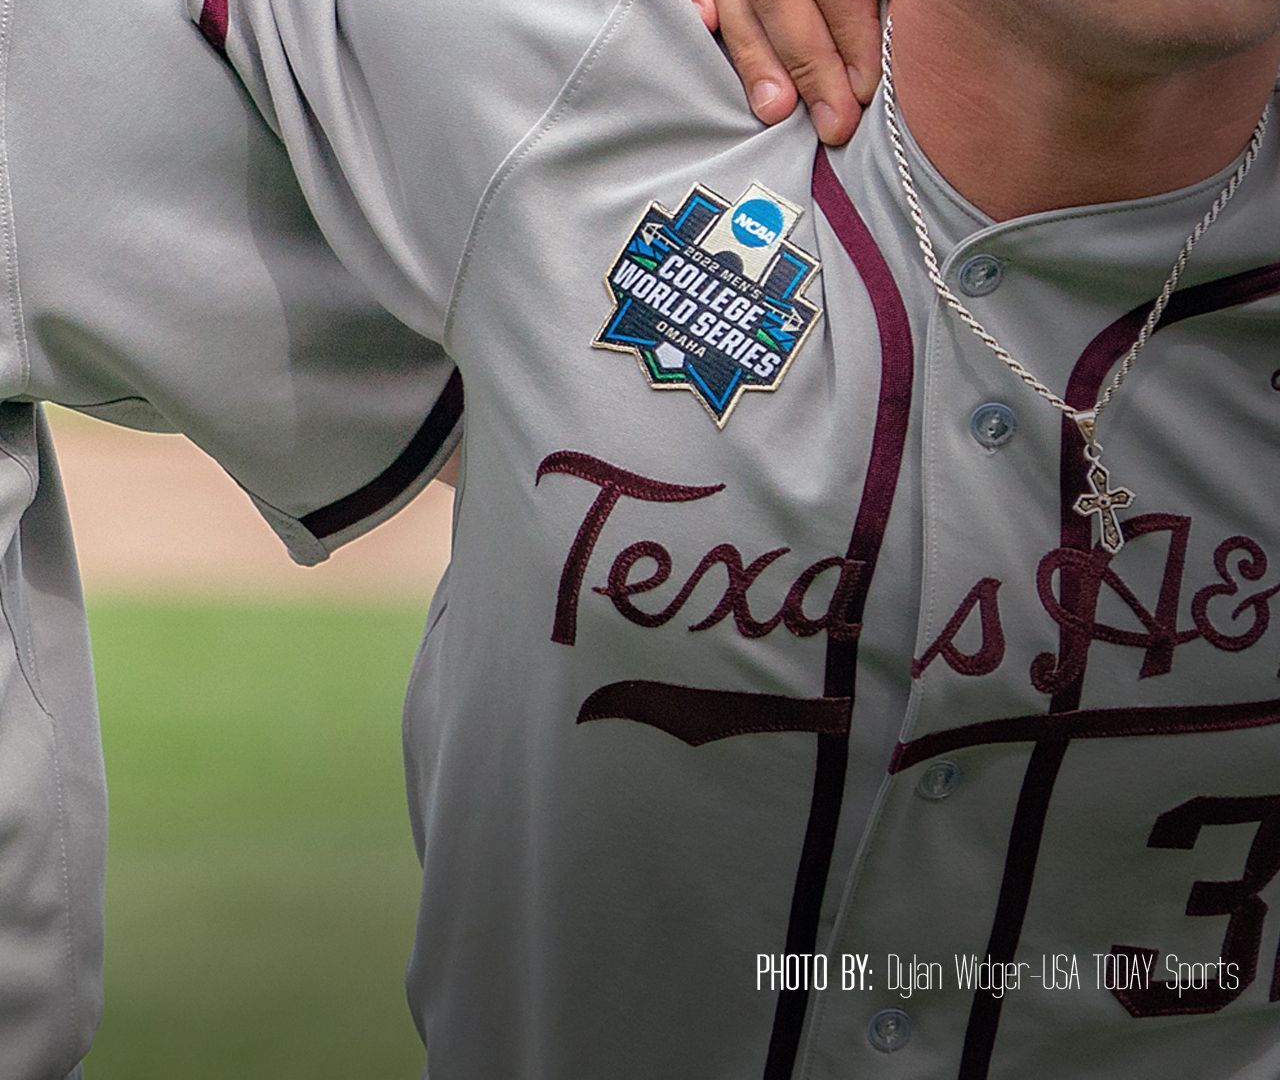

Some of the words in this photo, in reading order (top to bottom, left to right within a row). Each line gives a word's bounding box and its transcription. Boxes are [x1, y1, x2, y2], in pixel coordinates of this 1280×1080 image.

[733, 211, 777, 246] NCAA
[658, 254, 766, 332] COLLEGE
[683, 246, 720, 273] 2022
[720, 270, 763, 301] MEN'S
[612, 259, 698, 325] WORLD
[689, 311, 783, 378] SERIES
[656, 320, 707, 358] OMAHA
[535, 450, 1006, 679] Texas
[1029, 513, 1280, 694] A&
[1106, 794, 1280, 1017] 3
